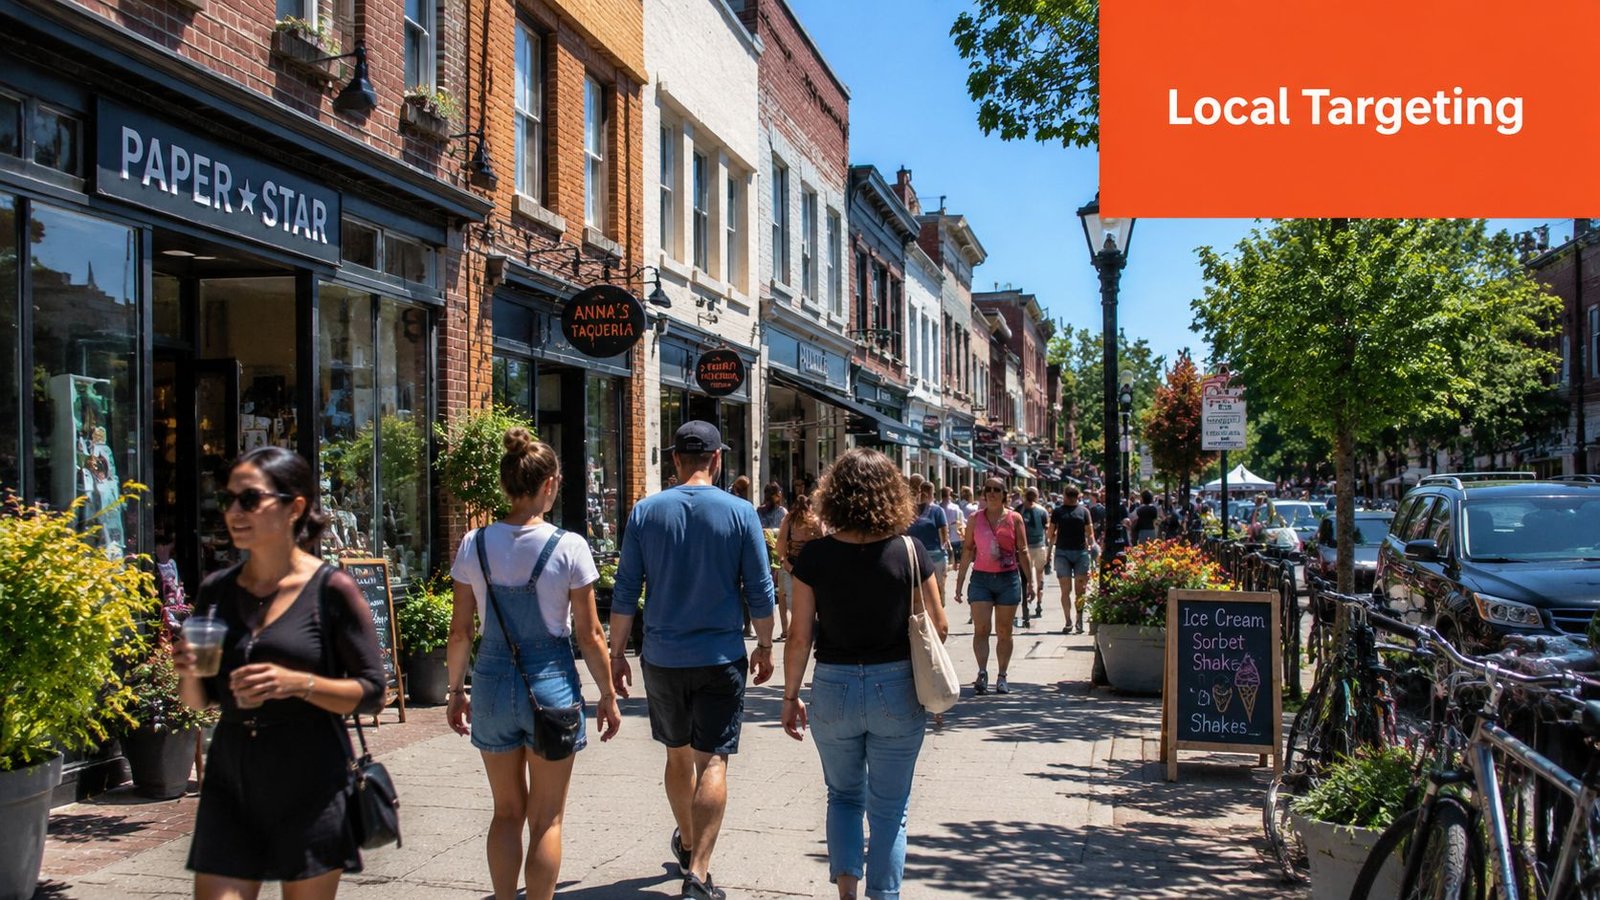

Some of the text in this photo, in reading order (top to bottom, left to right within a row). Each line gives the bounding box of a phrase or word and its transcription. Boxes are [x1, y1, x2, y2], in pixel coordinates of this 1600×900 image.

[120, 127, 328, 244] PAPER STAR
[574, 303, 630, 321] ANNA'S
[571, 323, 633, 343] TAQUERIA
[1183, 607, 1265, 629] Ice Cream
[1192, 632, 1245, 651] Sorbet
[1190, 712, 1247, 735] Shakes
